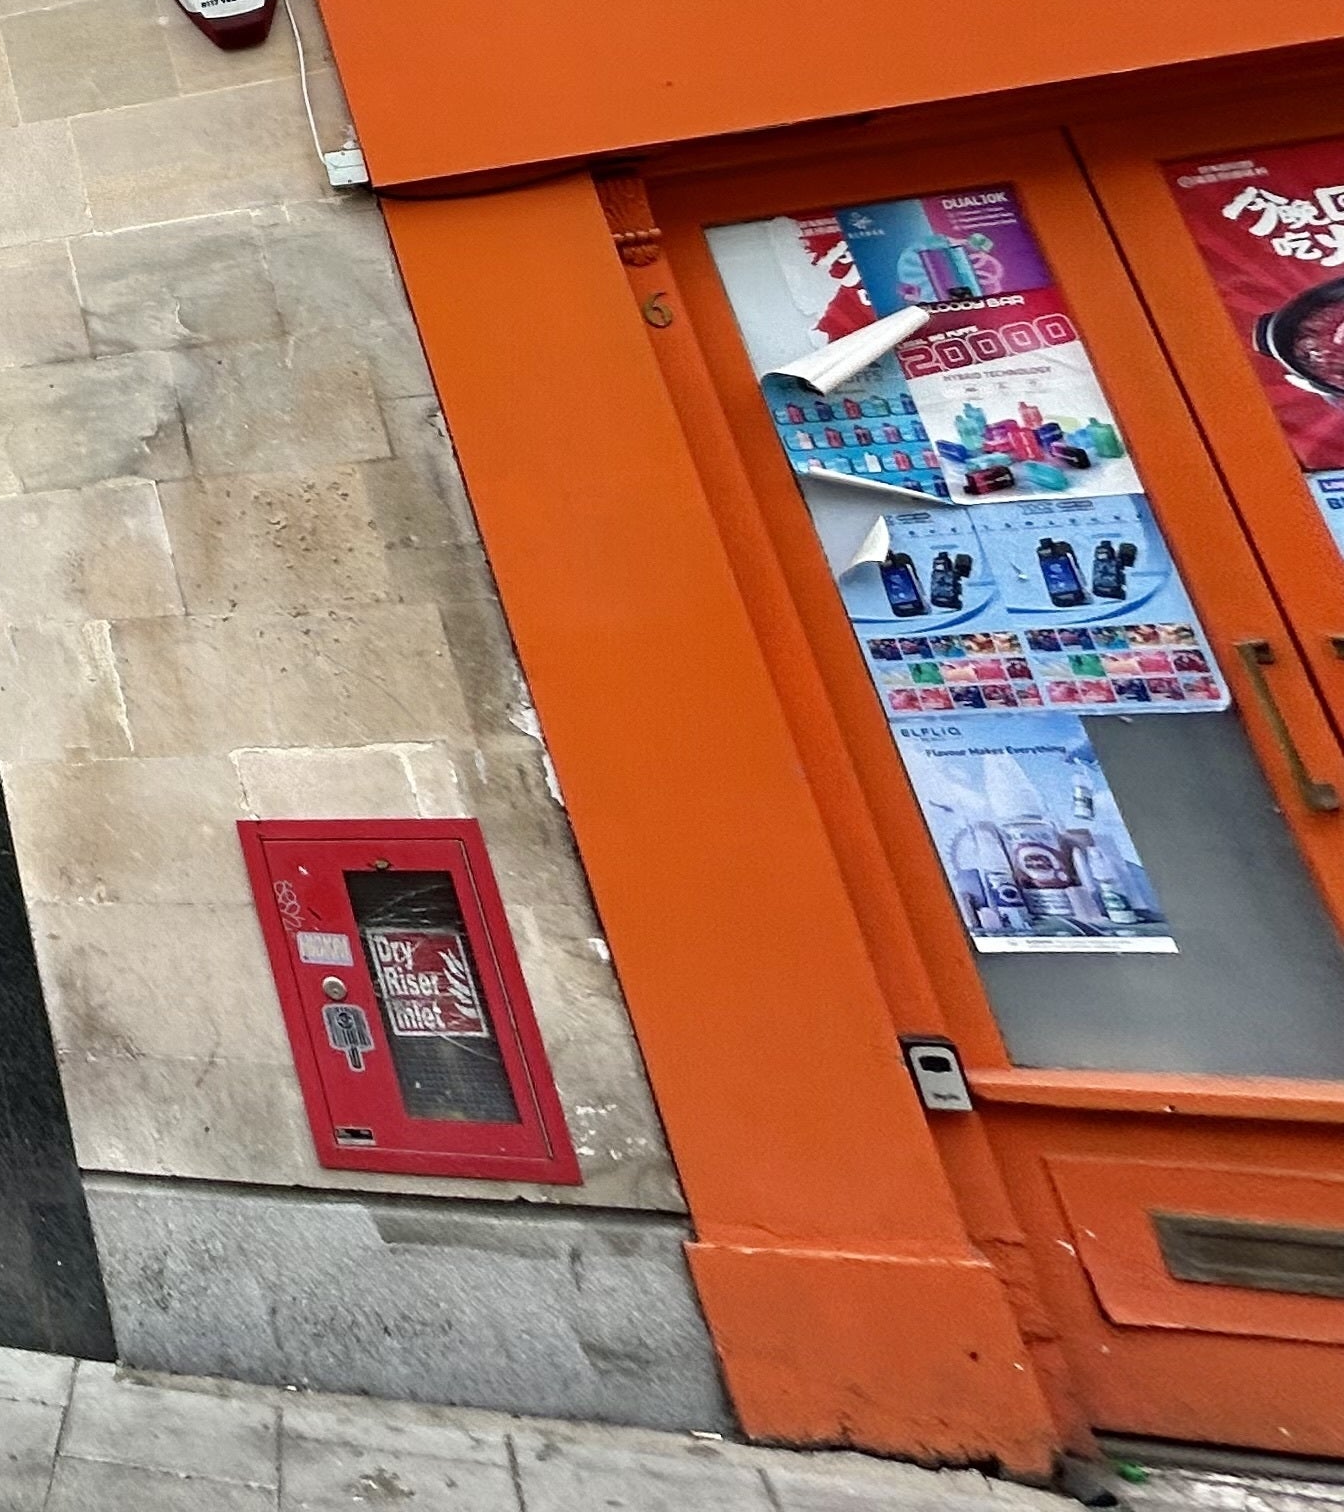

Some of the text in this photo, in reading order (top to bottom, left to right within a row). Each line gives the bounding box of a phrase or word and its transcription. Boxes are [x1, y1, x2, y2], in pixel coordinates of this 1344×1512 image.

[643, 292, 673, 328] 6
[987, 295, 1025, 308] BAR
[899, 313, 1079, 379] 20000
[373, 935, 413, 970] Dry
[383, 967, 440, 996] Riser
[392, 999, 446, 1030] Inlet
